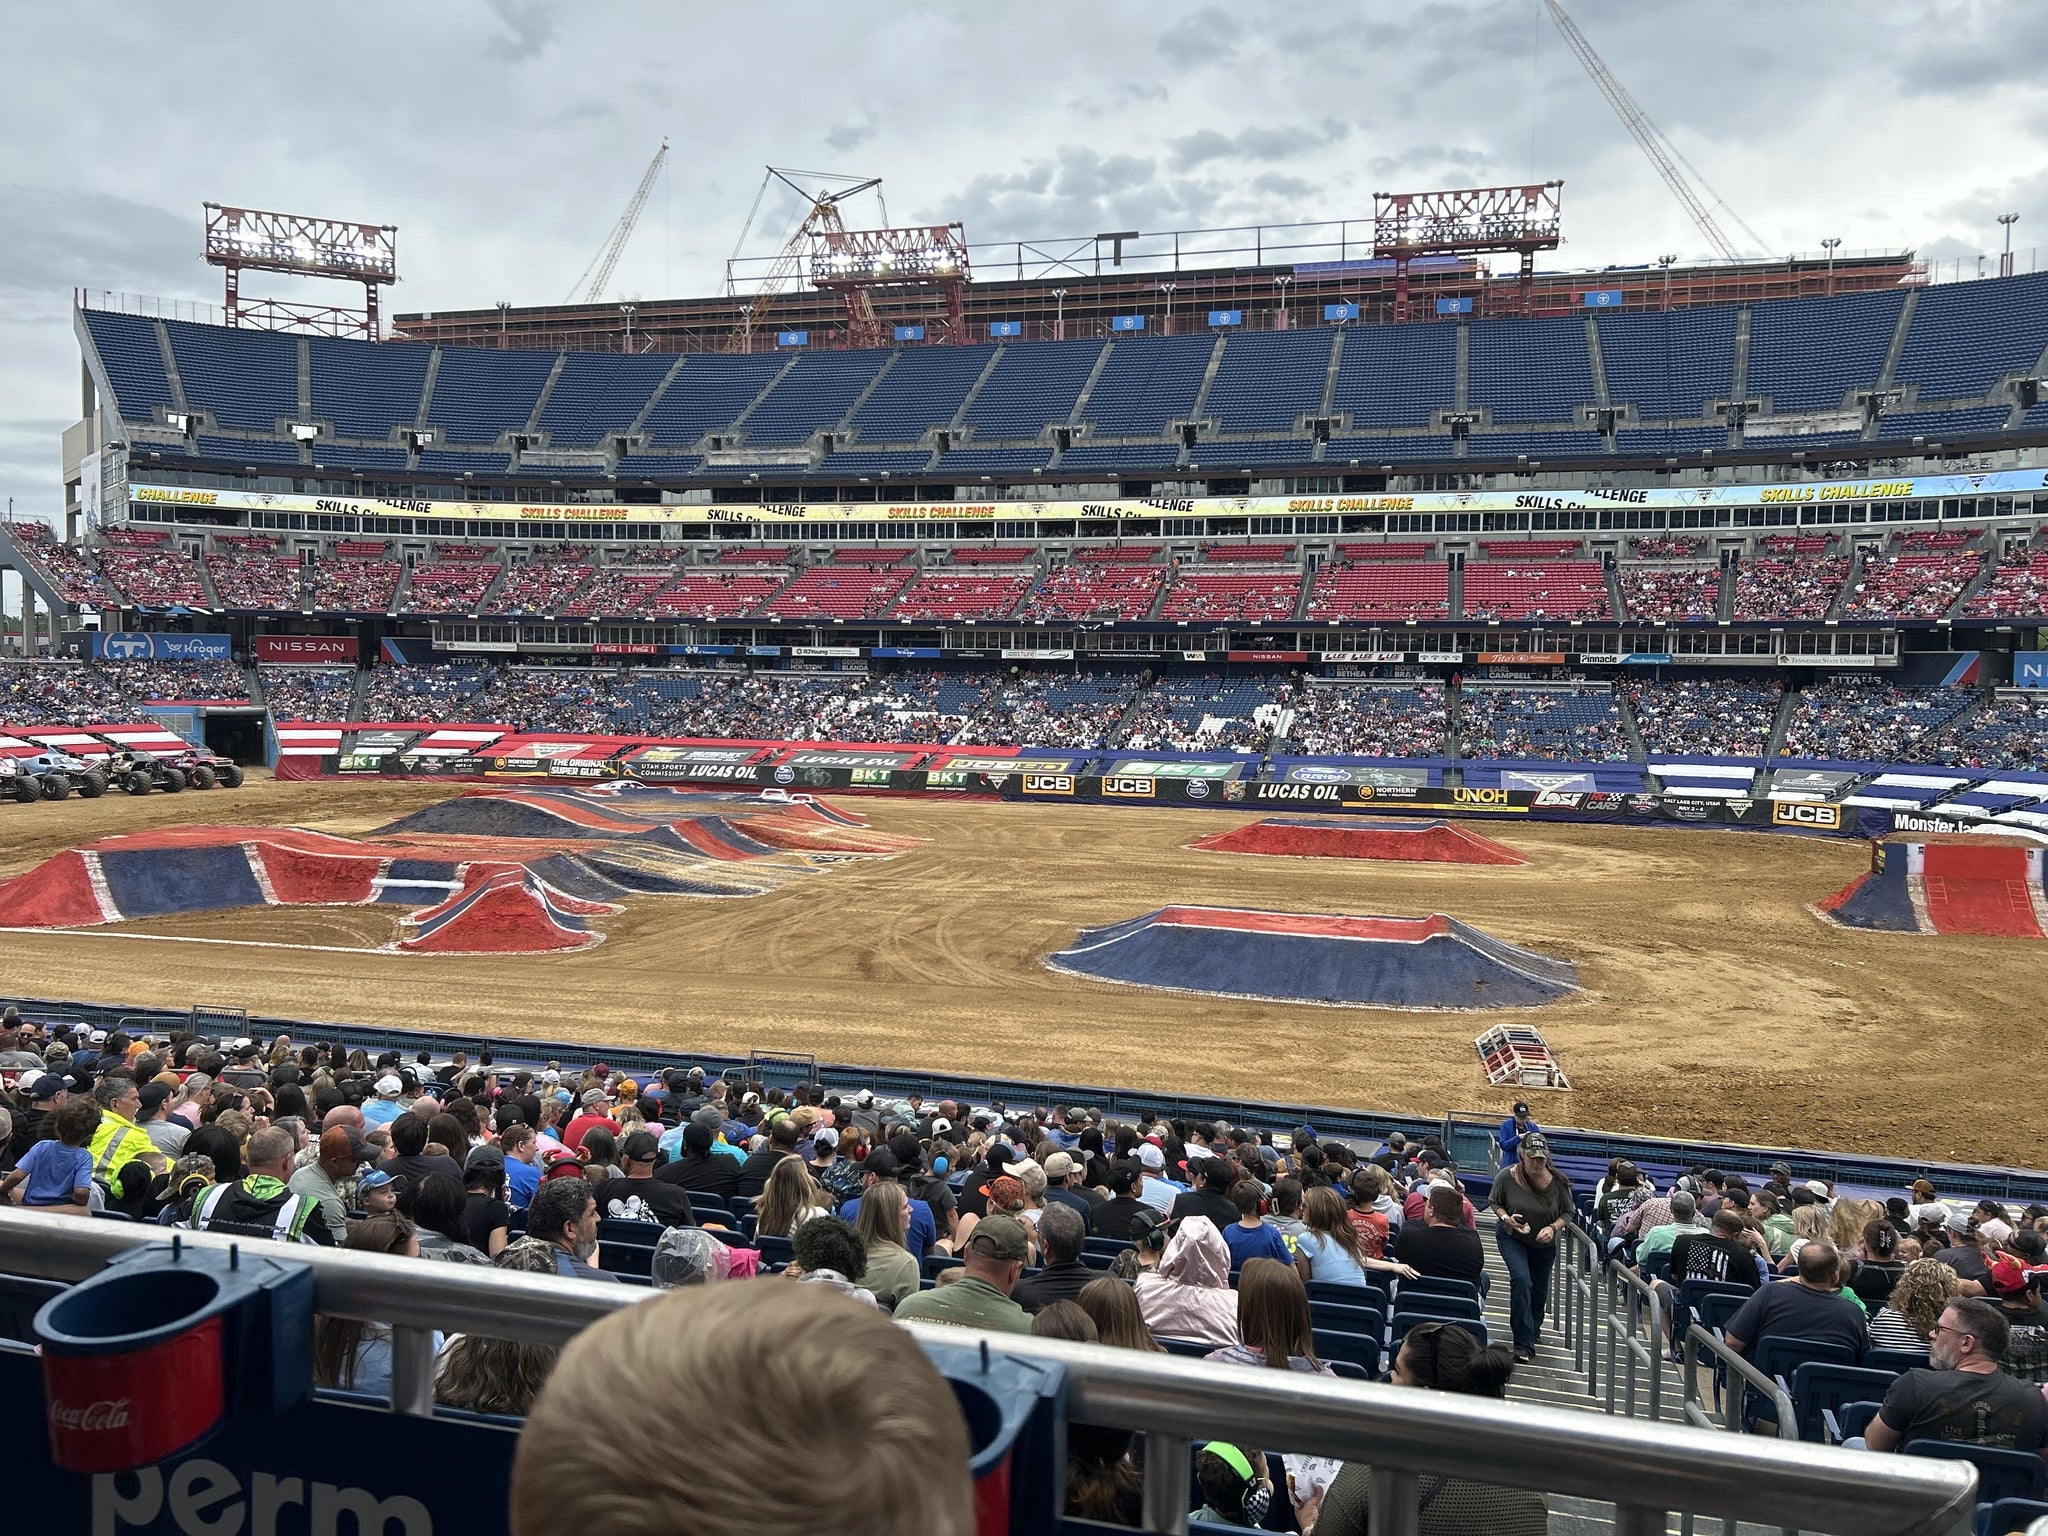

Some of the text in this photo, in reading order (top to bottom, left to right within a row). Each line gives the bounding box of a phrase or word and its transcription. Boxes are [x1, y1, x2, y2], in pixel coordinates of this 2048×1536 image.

[137, 487, 218, 505] CHALLENGE
[1759, 482, 1915, 503] SKILLS CHALLENGE
[315, 499, 358, 516] SKILLS
[1288, 498, 1414, 513] SKILLS CHALLENGE
[1515, 495, 1563, 510] SKILLS
[520, 507, 629, 521] SKILLS CHALLENGE
[707, 509, 743, 523] SKILLS
[888, 506, 995, 519] SKILLS CHALLENGE
[1081, 504, 1122, 519] SKILLS
[185, 639, 225, 657] Kroger
[269, 642, 345, 652] NISSAN
[1491, 654, 1517, 662] Tito's
[1581, 655, 1617, 663] Pinnacle
[553, 758, 607, 768] THE ORIGINAL
[550, 766, 602, 777] SUPER GLUE
[688, 765, 735, 778] LUCAS
[851, 769, 891, 780] BKT
[927, 771, 968, 783] BKT
[1026, 775, 1071, 791] JCB
[1105, 778, 1152, 793] JCB
[1257, 784, 1311, 799] LUCAS
[1453, 787, 1508, 803] UNOH
[1591, 793, 1607, 801] RC
[1586, 801, 1621, 810] CARS
[1778, 805, 1836, 824] JCB
[50, 1398, 131, 1431] Coca-Cola
[90, 1458, 435, 1536] perm
